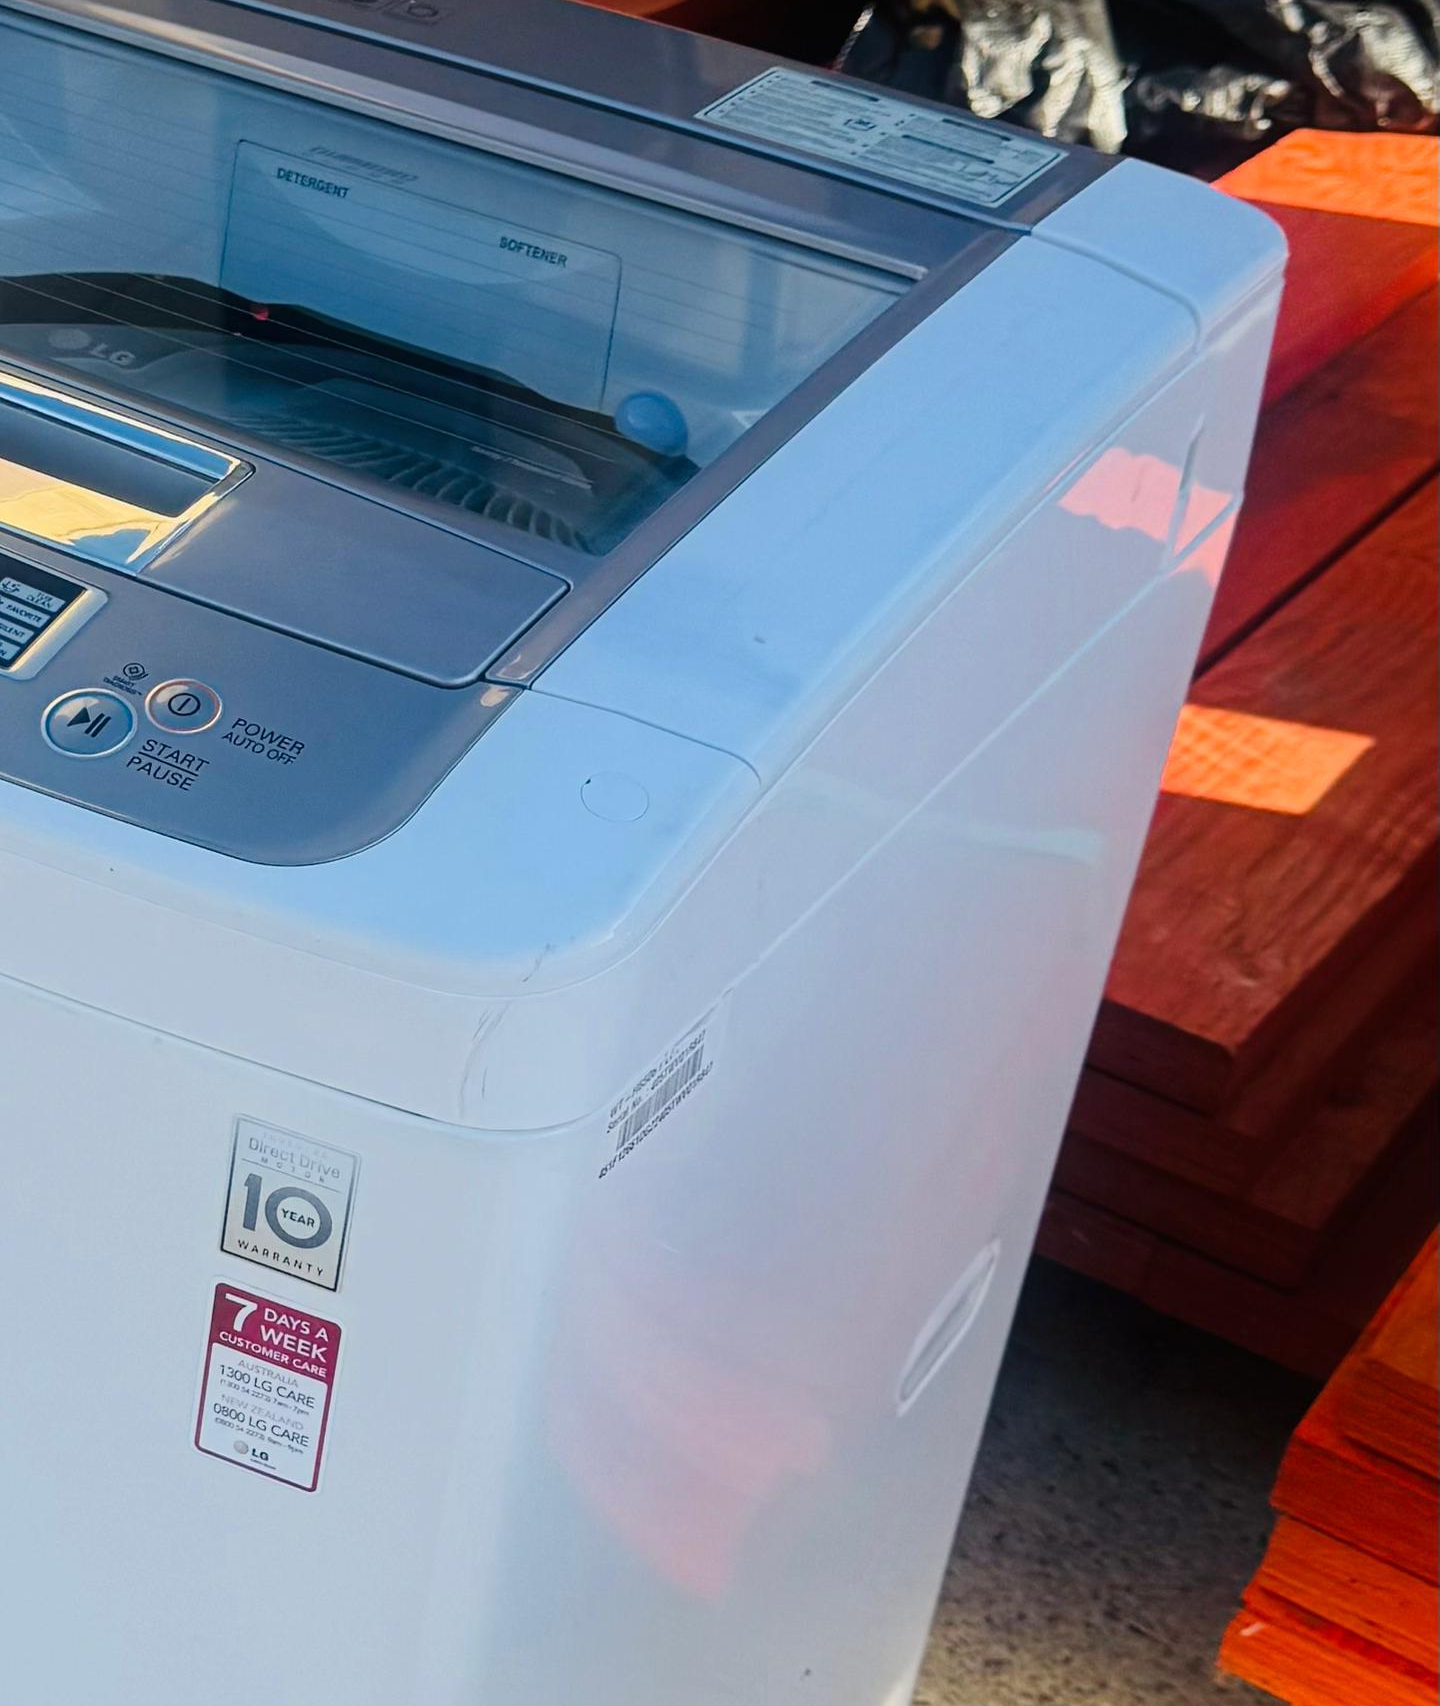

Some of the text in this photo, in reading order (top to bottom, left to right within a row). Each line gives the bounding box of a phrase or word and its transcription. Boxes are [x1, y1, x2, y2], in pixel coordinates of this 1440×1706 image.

[276, 167, 349, 198] DETERGENT
[498, 235, 568, 267] SOFTENER
[89, 343, 137, 366] LG
[142, 738, 210, 772] START
[222, 730, 297, 767] AUTO OFF
[232, 717, 306, 756] POWER
[127, 755, 195, 792] PAUSE
[300, 1153, 341, 1180] Drive
[242, 1173, 333, 1250] 10
[280, 1207, 316, 1229] YEAR
[237, 1238, 325, 1277] WARRANTY
[224, 1292, 258, 1332] 7
[263, 1307, 329, 1343] DAYS A
[219, 1330, 328, 1379] CUSTOMER CARE
[260, 1324, 328, 1364] WEEK
[219, 1364, 316, 1409] 1300 LG CARE
[237, 1359, 299, 1389] AUSTRALIA
[213, 1402, 246, 1424] 0800
[248, 1415, 267, 1432] LG
[270, 1424, 310, 1448] CARE
[251, 1447, 269, 1462] LG
